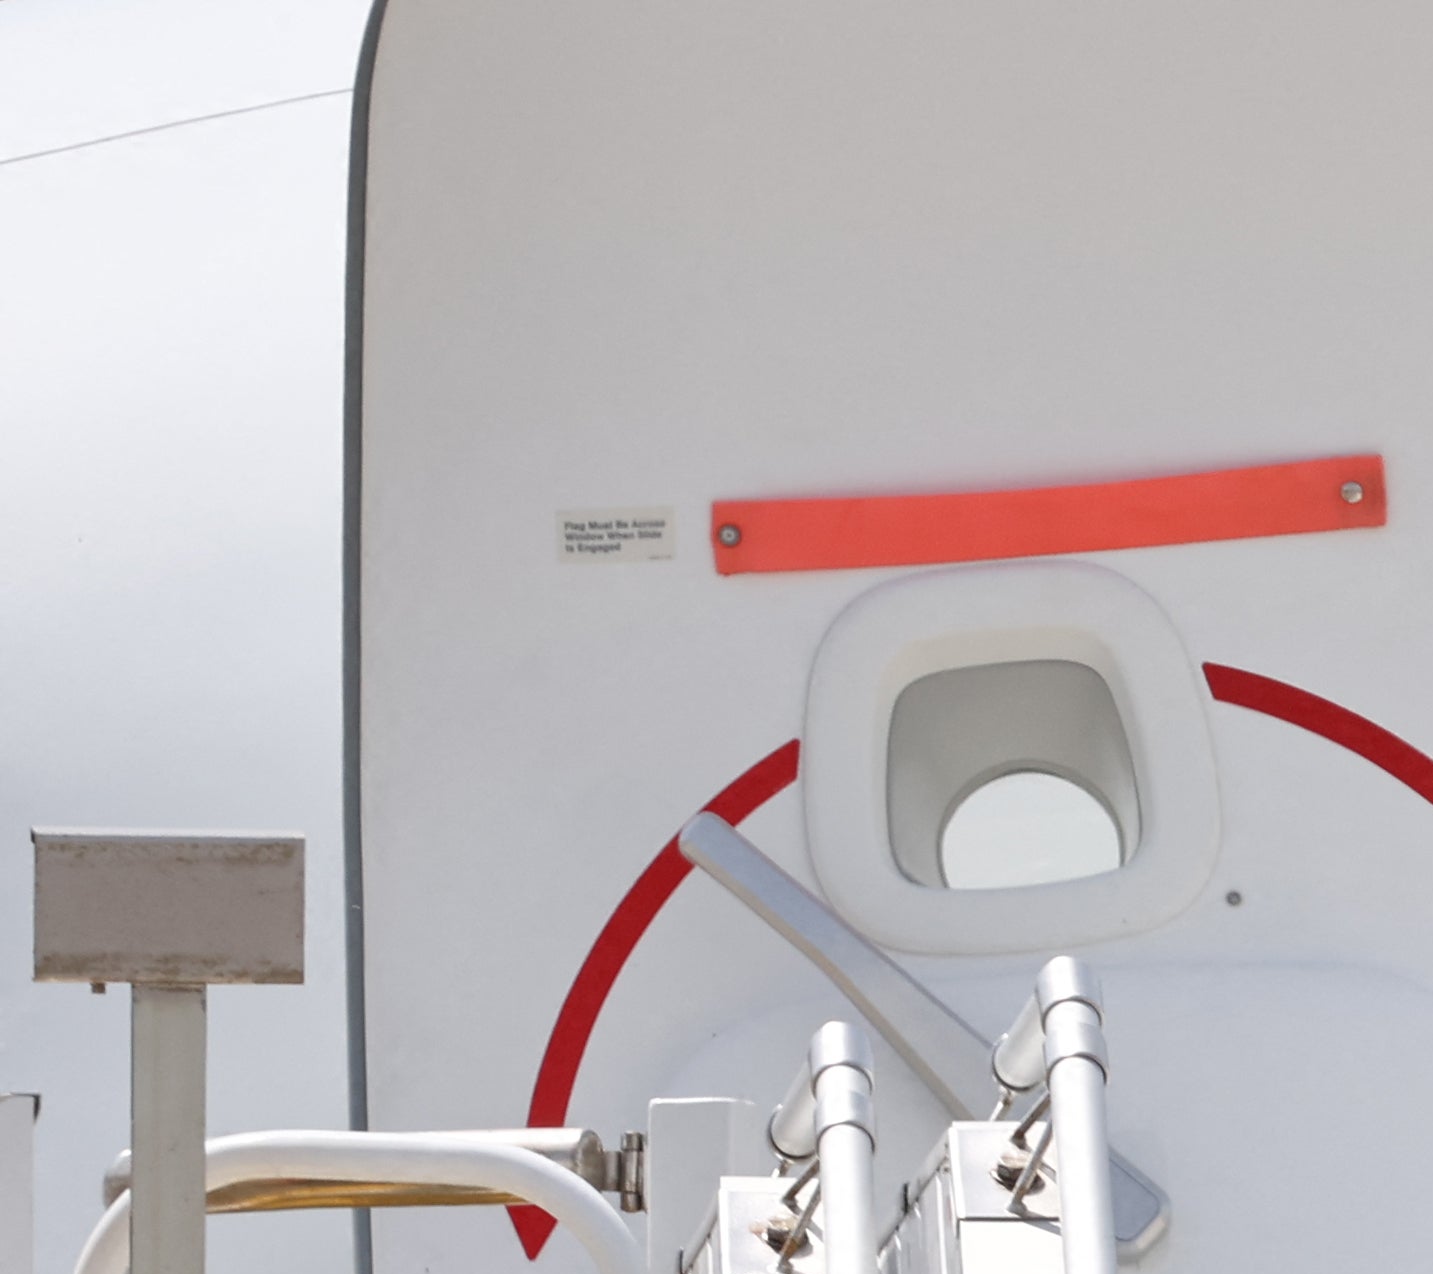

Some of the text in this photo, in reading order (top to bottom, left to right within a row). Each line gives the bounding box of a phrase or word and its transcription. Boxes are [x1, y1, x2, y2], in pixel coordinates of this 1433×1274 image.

[587, 521, 613, 530] Must
[615, 520, 629, 528] Be
[565, 532, 604, 541] Window
[606, 532, 635, 540] When
